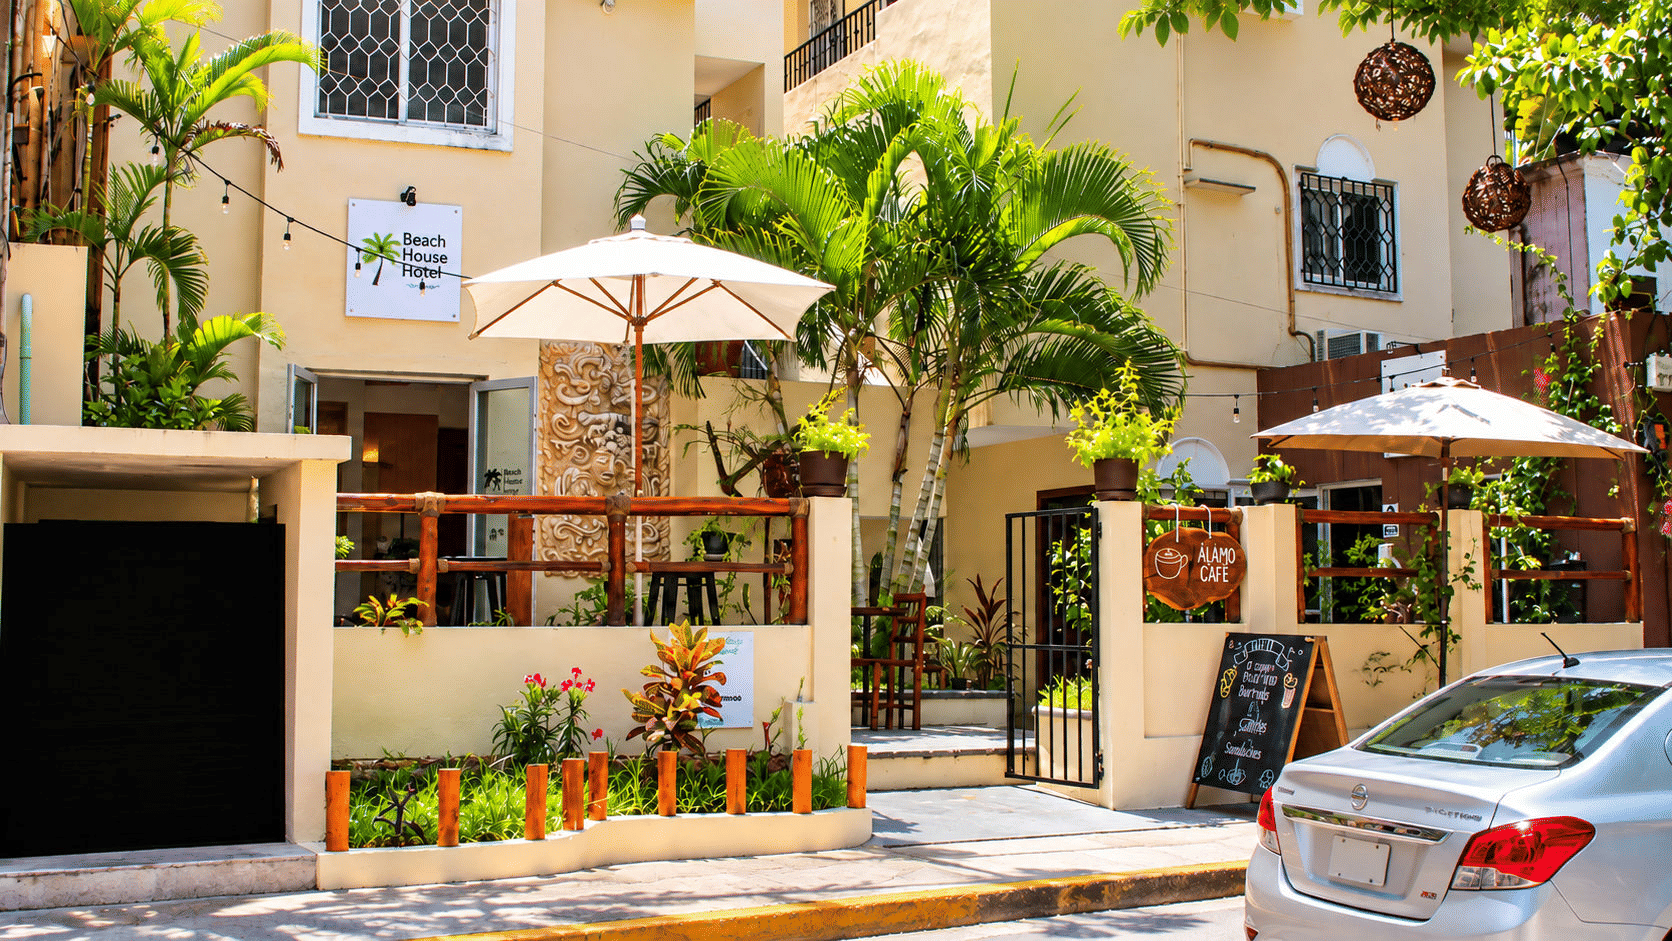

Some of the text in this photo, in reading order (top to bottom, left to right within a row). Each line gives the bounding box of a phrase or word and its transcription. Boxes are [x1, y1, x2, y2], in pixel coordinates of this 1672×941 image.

[403, 232, 446, 248] Beach
[402, 248, 448, 264] House
[402, 263, 441, 279] Hotel
